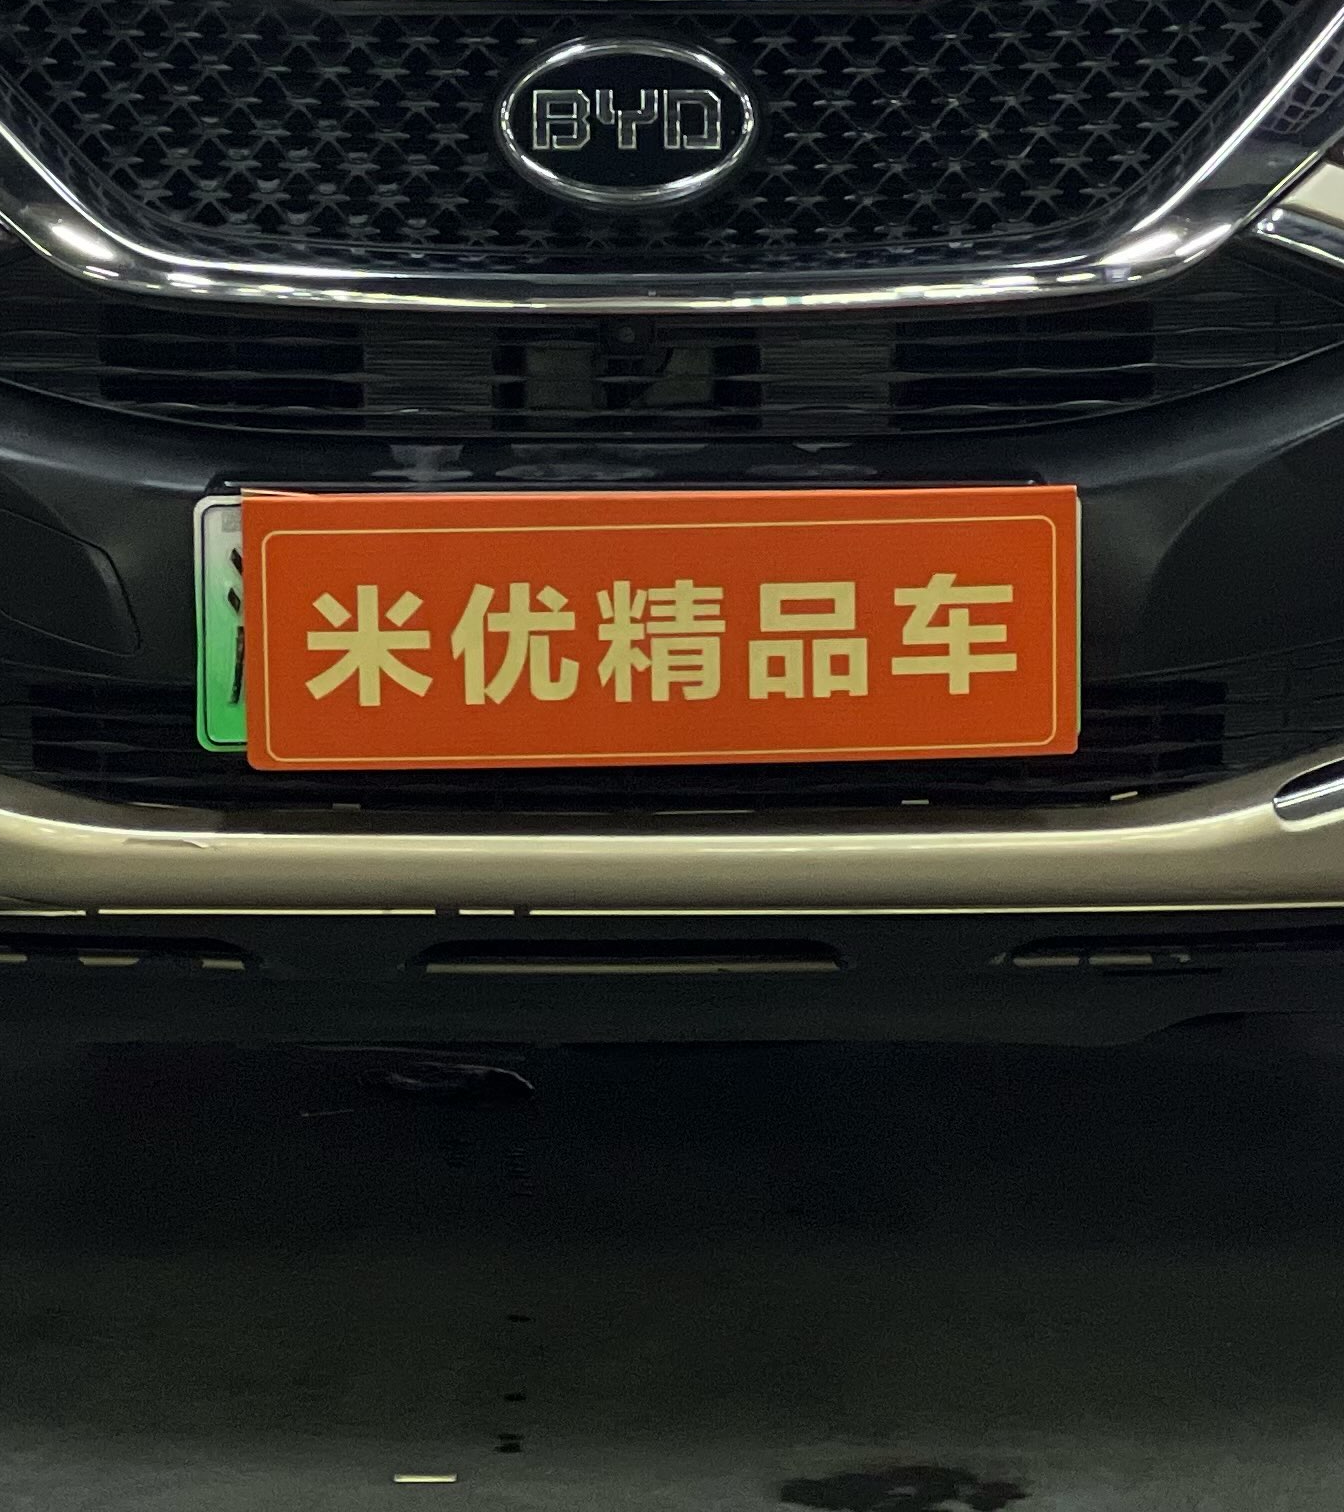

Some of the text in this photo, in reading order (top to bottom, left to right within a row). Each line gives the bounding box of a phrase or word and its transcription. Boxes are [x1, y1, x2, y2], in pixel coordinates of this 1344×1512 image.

[532, 88, 722, 151] BYD
[305, 572, 1018, 707] 米优精品车
